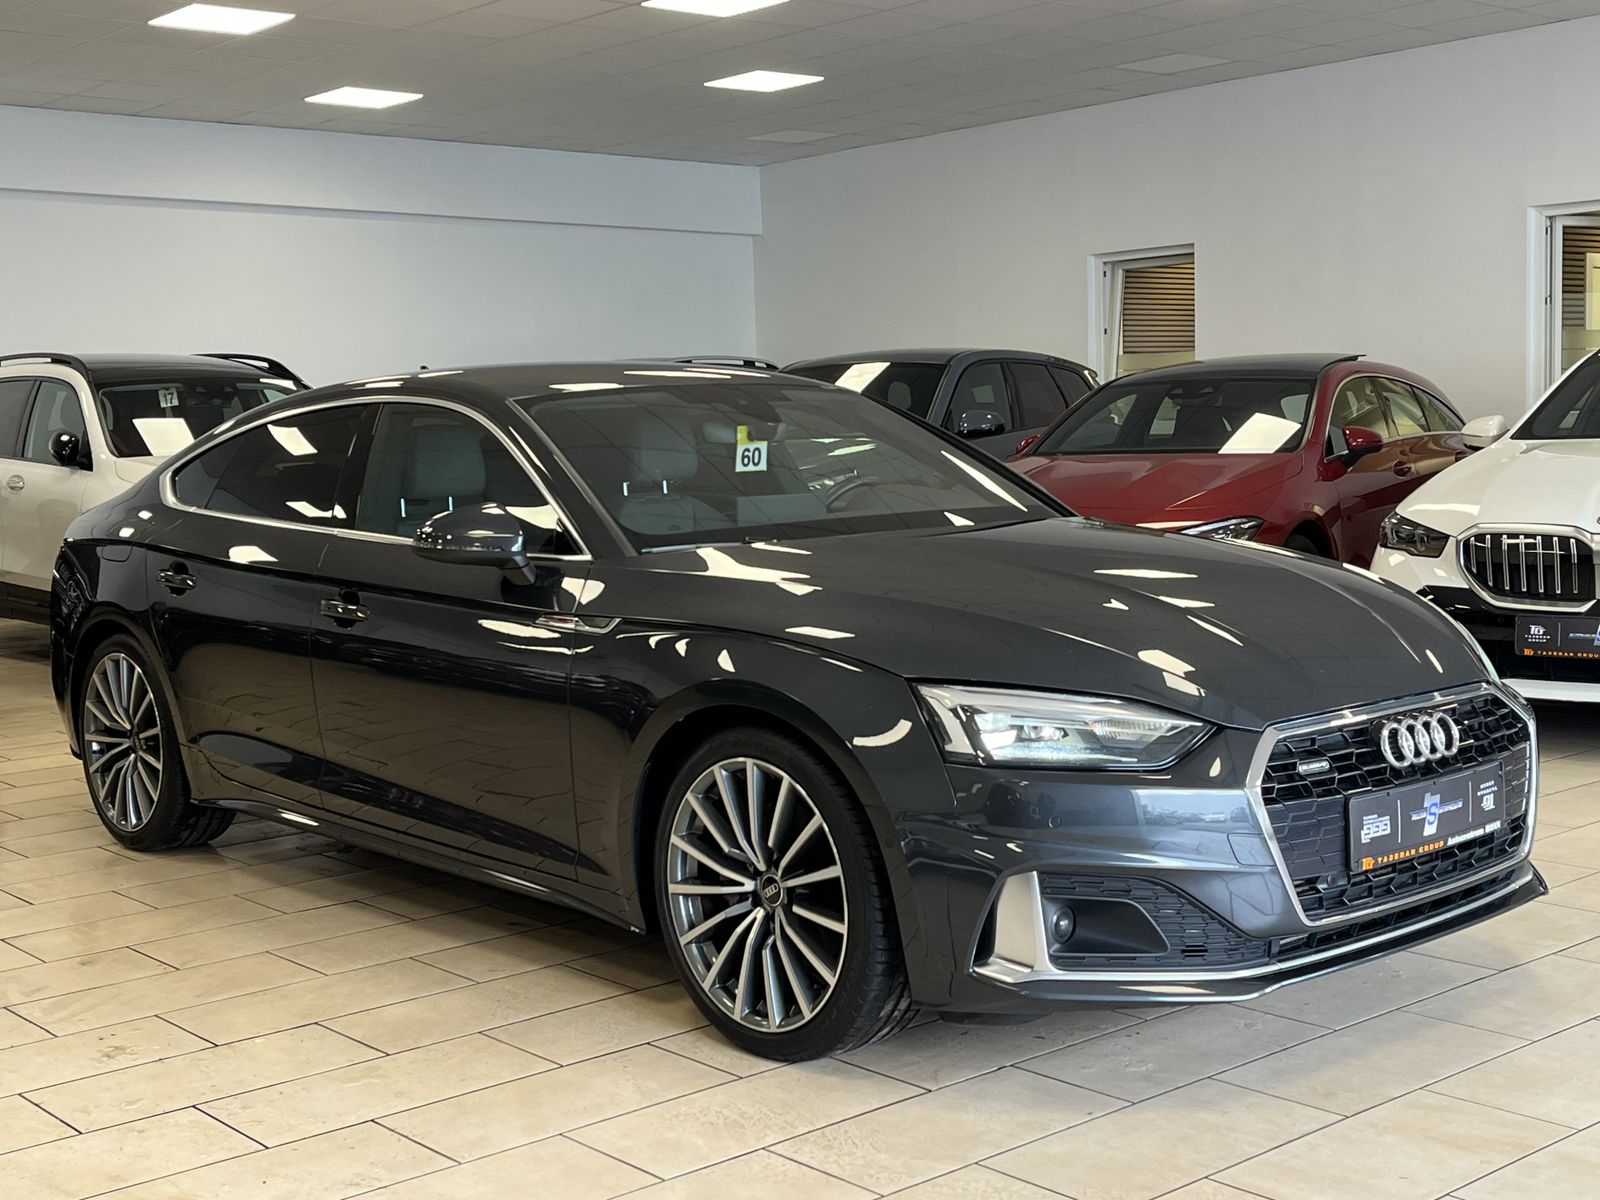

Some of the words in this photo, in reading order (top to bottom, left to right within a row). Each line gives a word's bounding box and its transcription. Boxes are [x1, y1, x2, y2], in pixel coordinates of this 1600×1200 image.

[163, 391, 175, 406] 17
[741, 446, 762, 467] 60
[1418, 840, 1445, 853] GROUP
